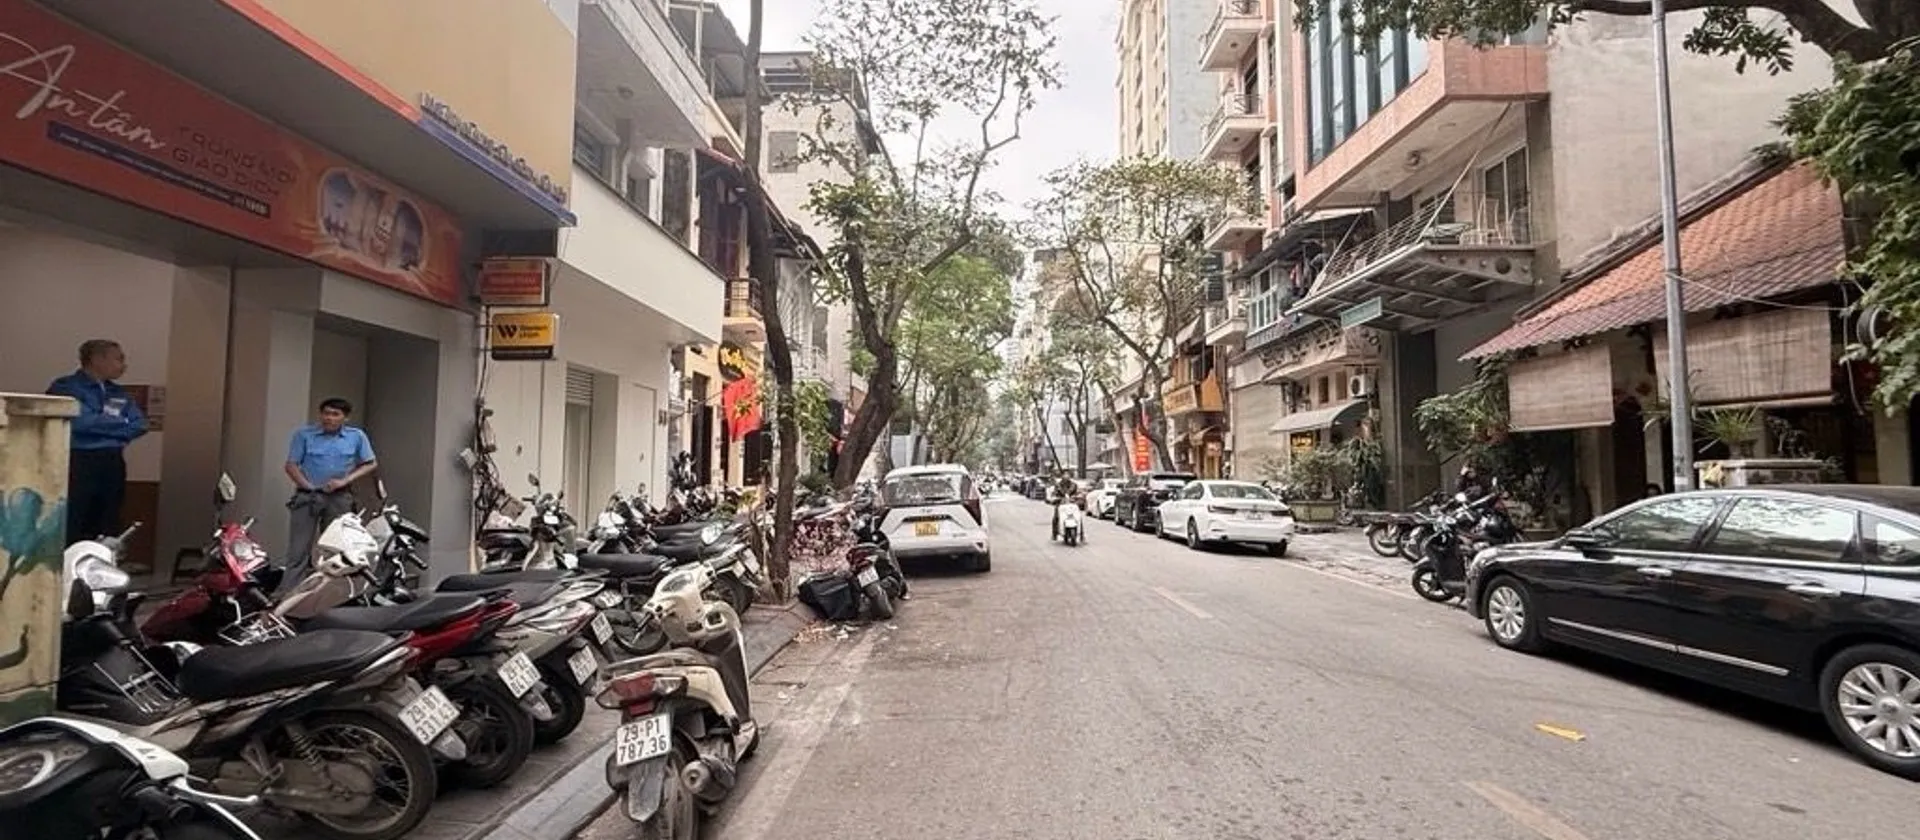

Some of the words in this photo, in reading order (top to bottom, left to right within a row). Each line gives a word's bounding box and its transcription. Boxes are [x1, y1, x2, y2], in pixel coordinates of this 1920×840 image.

[0, 32, 86, 119] An
[75, 89, 166, 149] tâm
[171, 145, 230, 180] GIAO
[624, 718, 660, 744] 29-P1
[619, 735, 667, 763] 787.36
